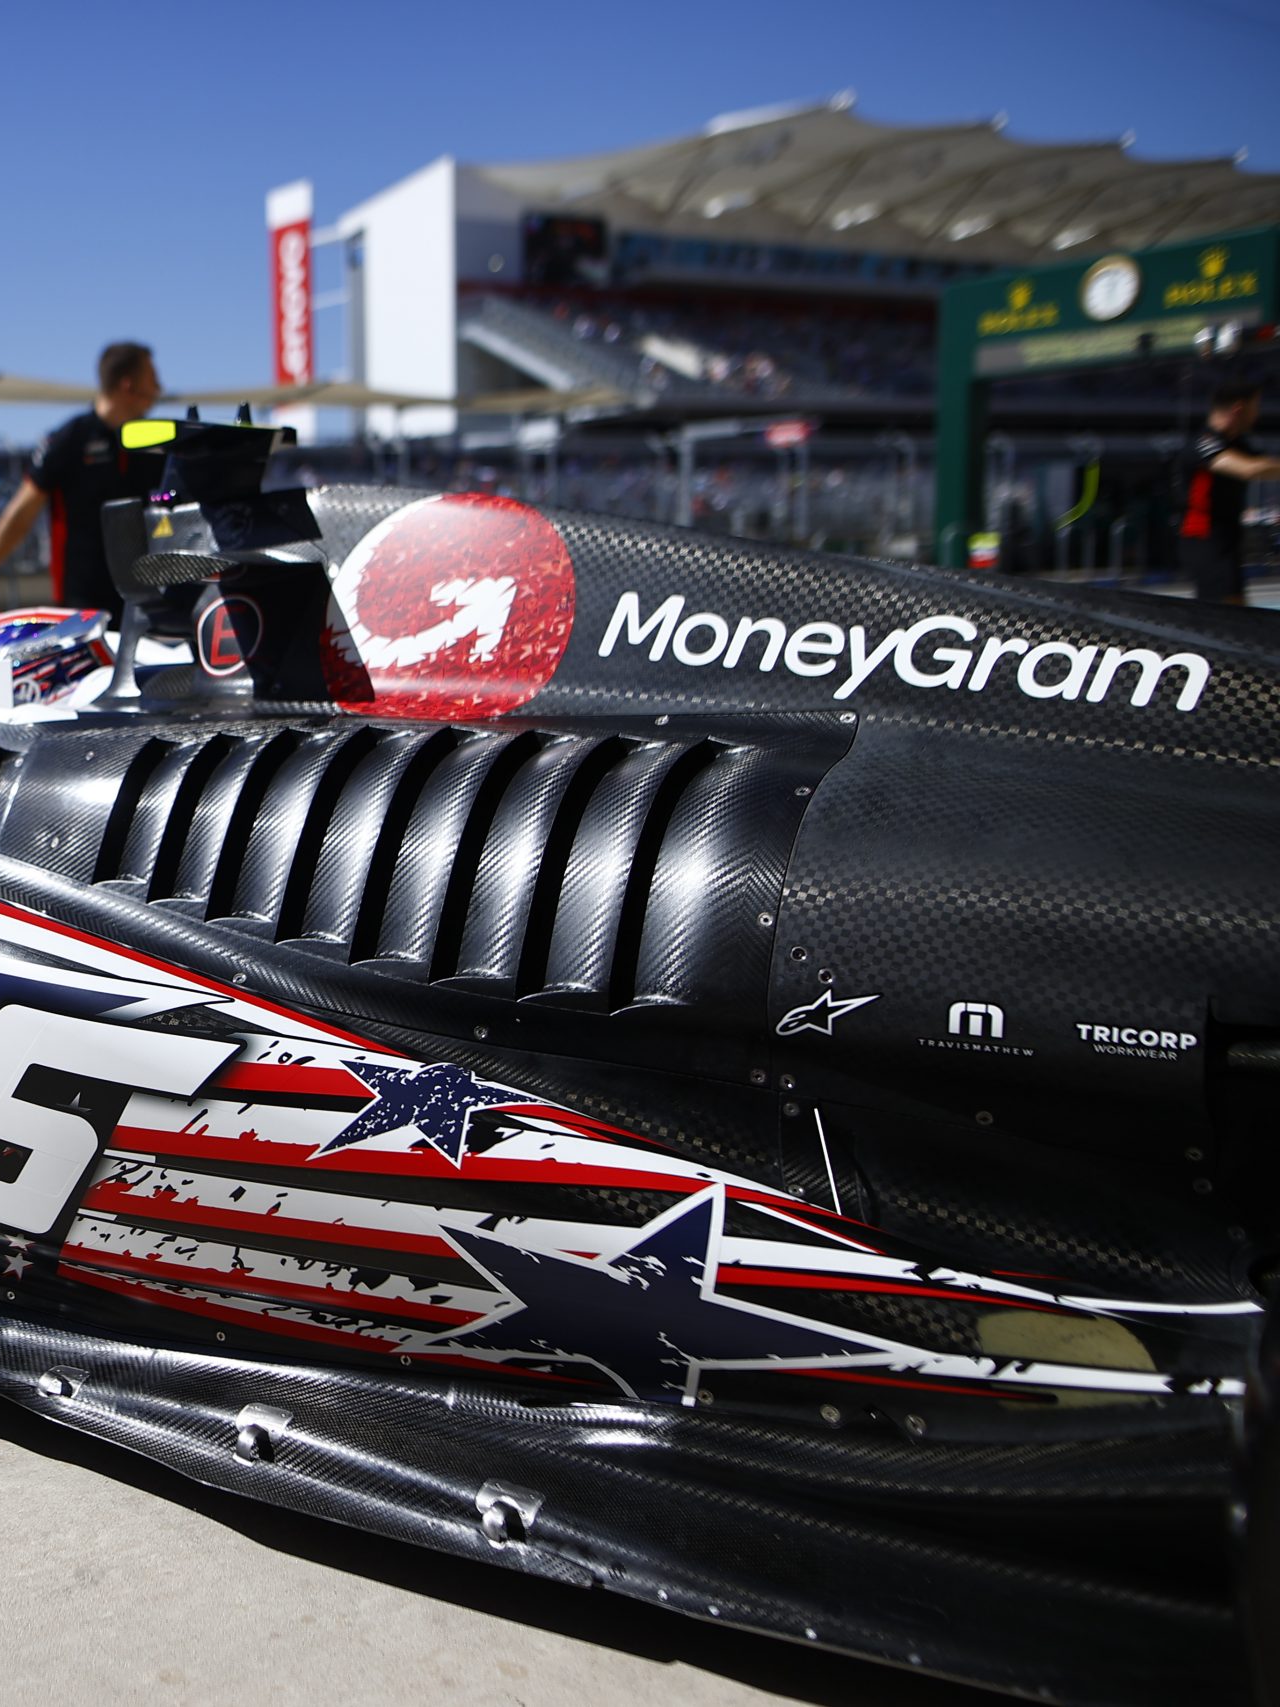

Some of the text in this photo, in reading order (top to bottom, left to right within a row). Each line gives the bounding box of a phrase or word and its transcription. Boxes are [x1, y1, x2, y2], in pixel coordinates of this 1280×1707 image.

[598, 591, 1210, 711] MoneyGram
[918, 1038, 1034, 1056] TRAVISMATHEW
[1076, 1023, 1198, 1050] TRICORP
[1092, 1043, 1178, 1061] WORKWEAR
